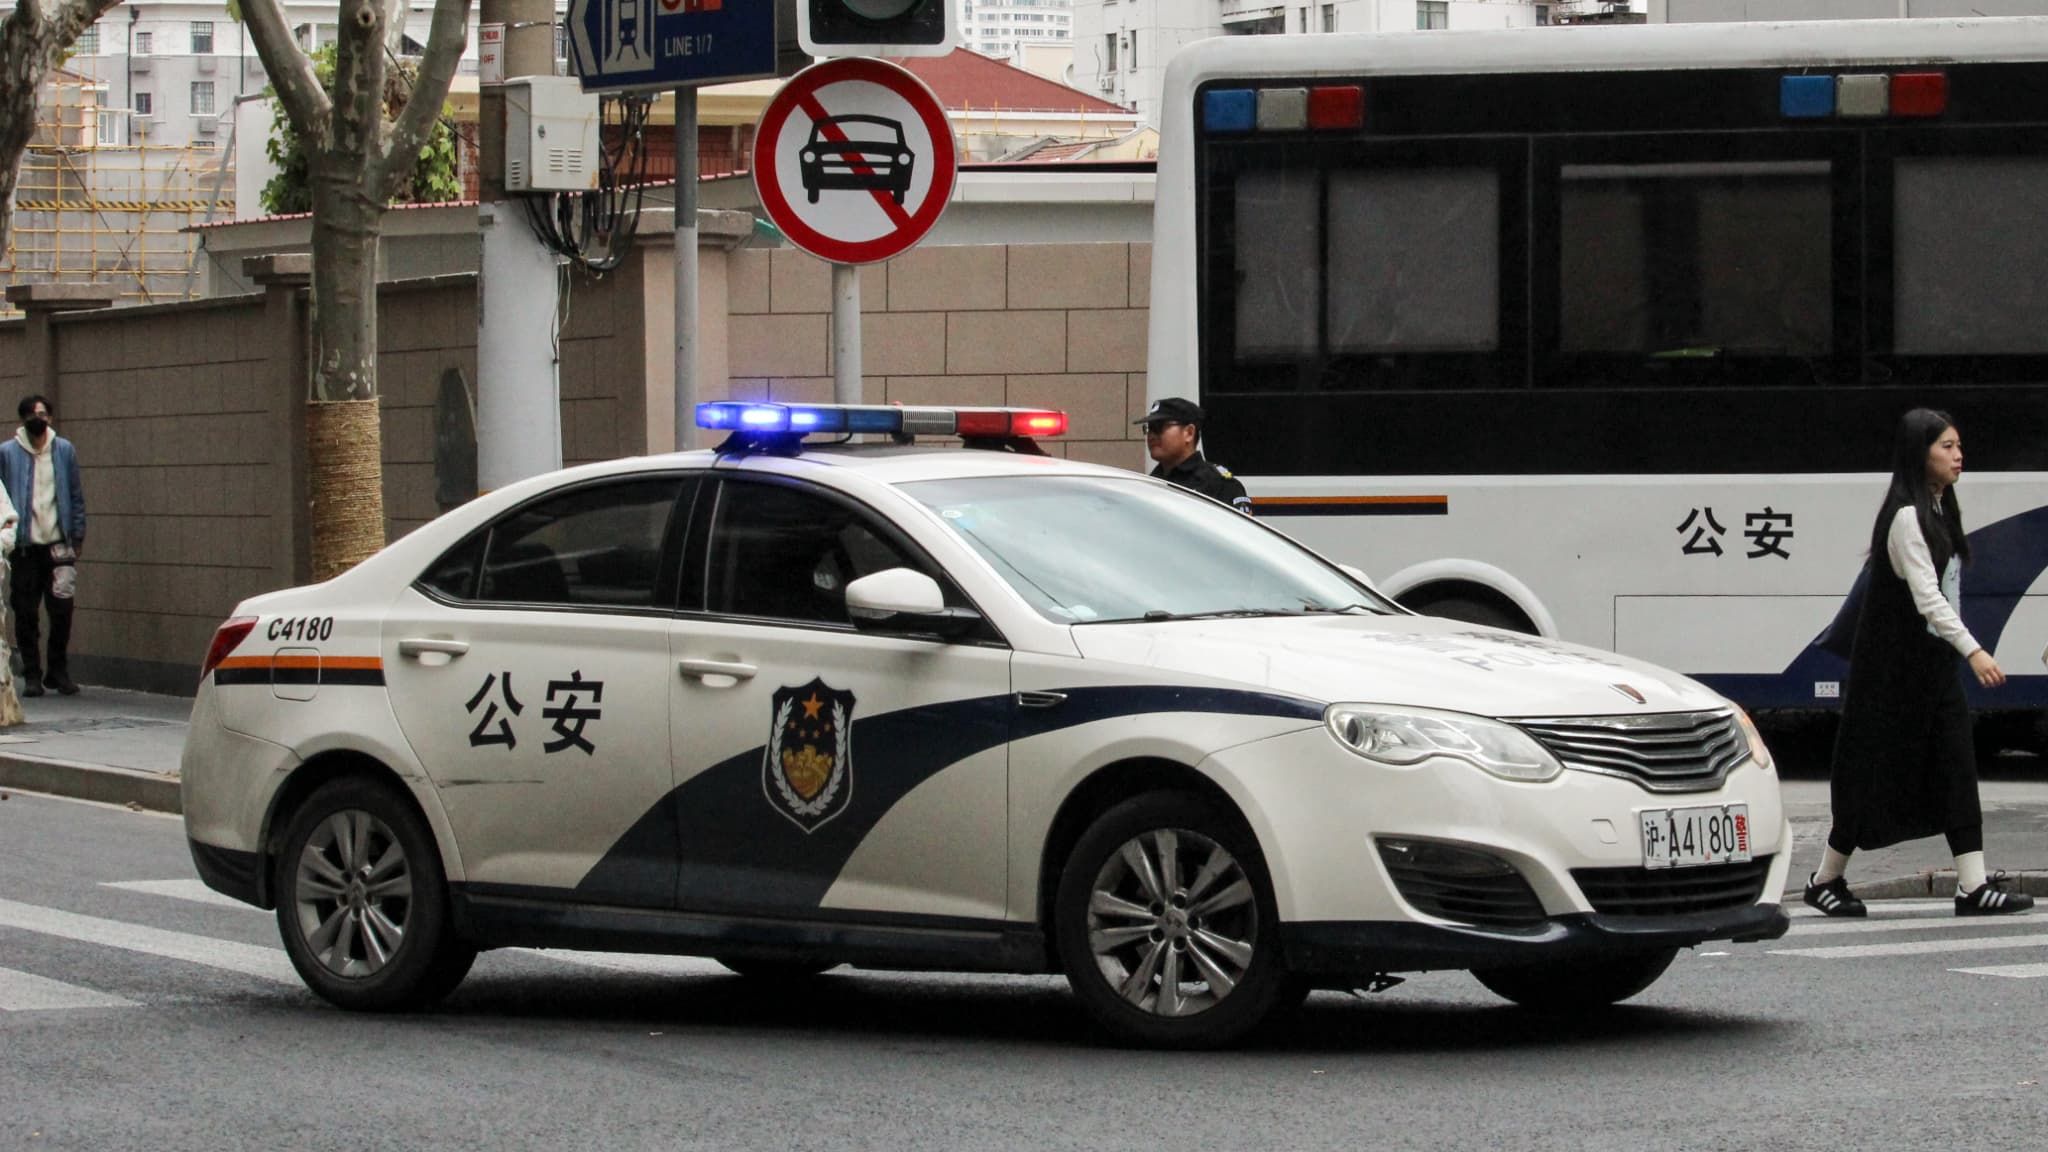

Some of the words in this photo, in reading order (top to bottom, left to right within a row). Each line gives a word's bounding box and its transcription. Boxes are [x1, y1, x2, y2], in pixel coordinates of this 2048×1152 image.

[664, 35, 693, 57] LINE
[1676, 506, 1794, 560] 公安
[267, 616, 334, 641] C4180
[465, 669, 604, 756] 公安
